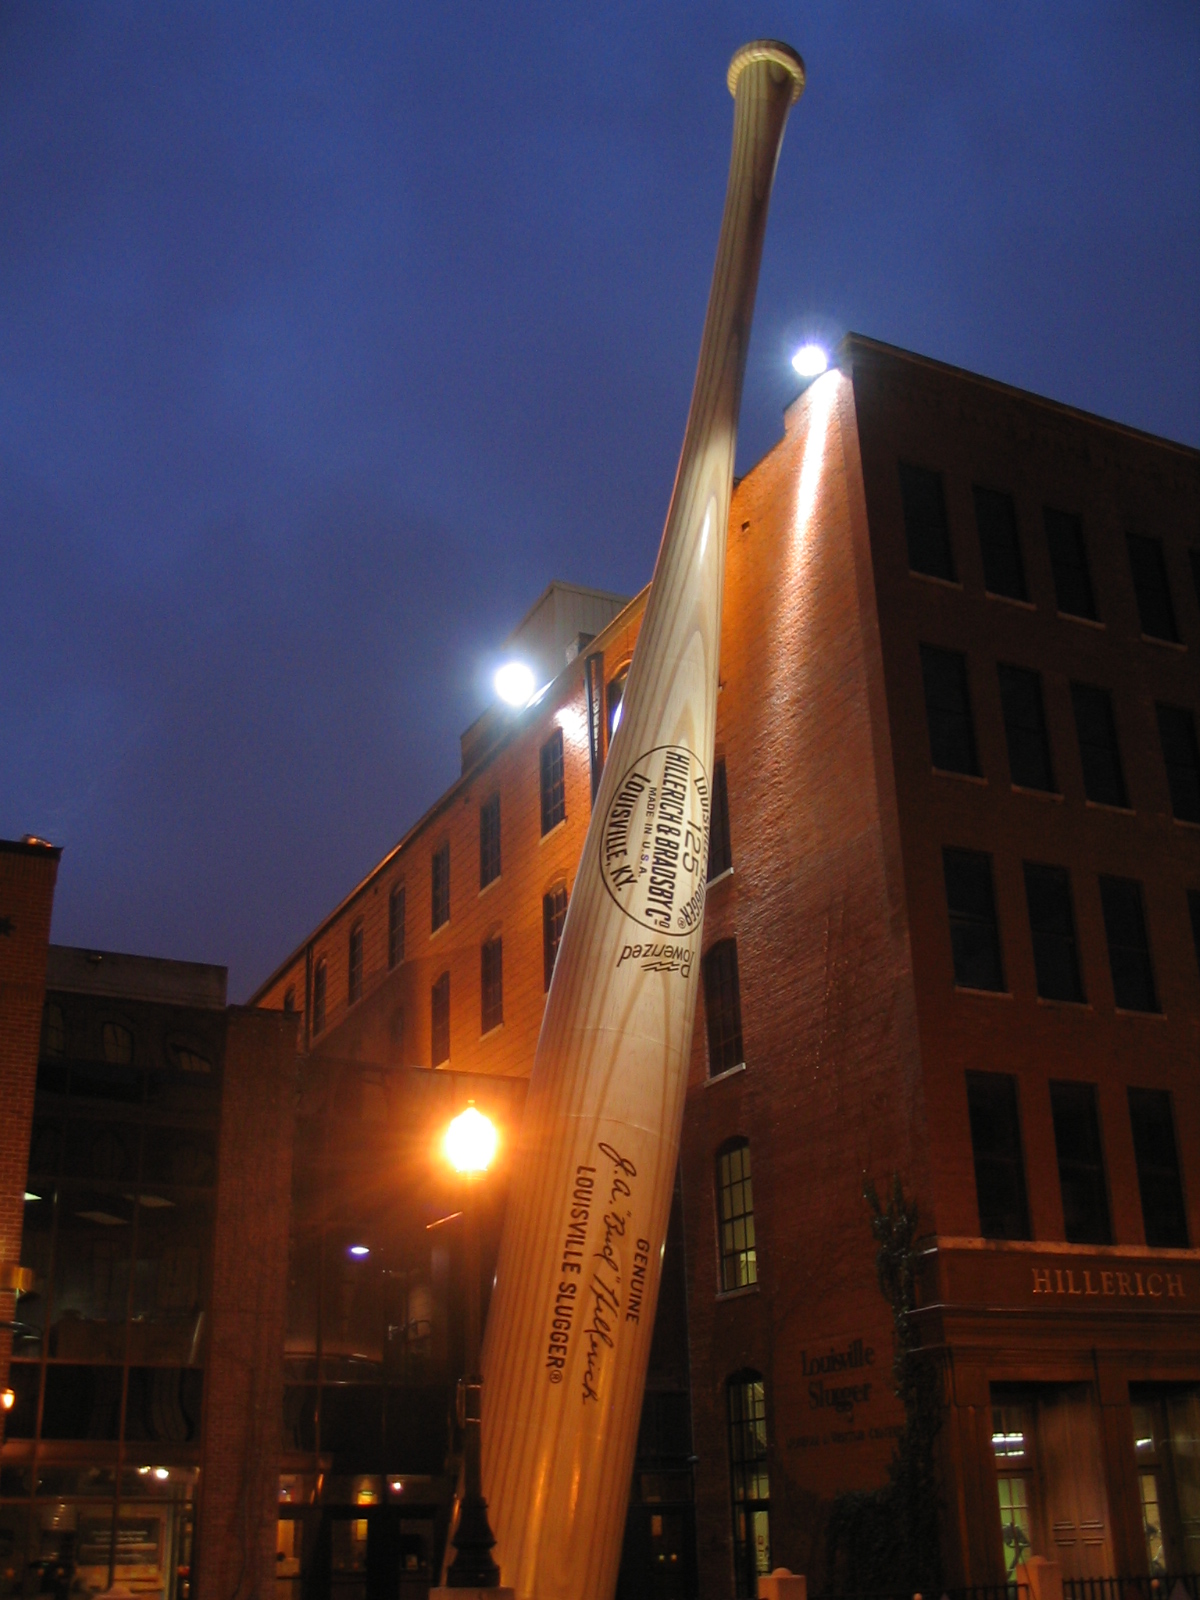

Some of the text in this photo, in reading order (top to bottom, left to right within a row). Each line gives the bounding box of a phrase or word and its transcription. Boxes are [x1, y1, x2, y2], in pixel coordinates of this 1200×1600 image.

[658, 750, 690, 825] HILLERICH
[605, 772, 652, 891] LOUISVILLE, KY.
[638, 787, 657, 877] MADE IN U.S.A.
[656, 824, 681, 836] &
[683, 820, 702, 877] 125
[647, 836, 680, 912] BRADSBY
[616, 944, 695, 978] Powerized
[561, 1165, 597, 1274] LOUISVILLE
[625, 1238, 650, 1325] GENUINE
[1031, 1267, 1186, 1298] HILLERICH
[799, 1338, 875, 1377] Louisville
